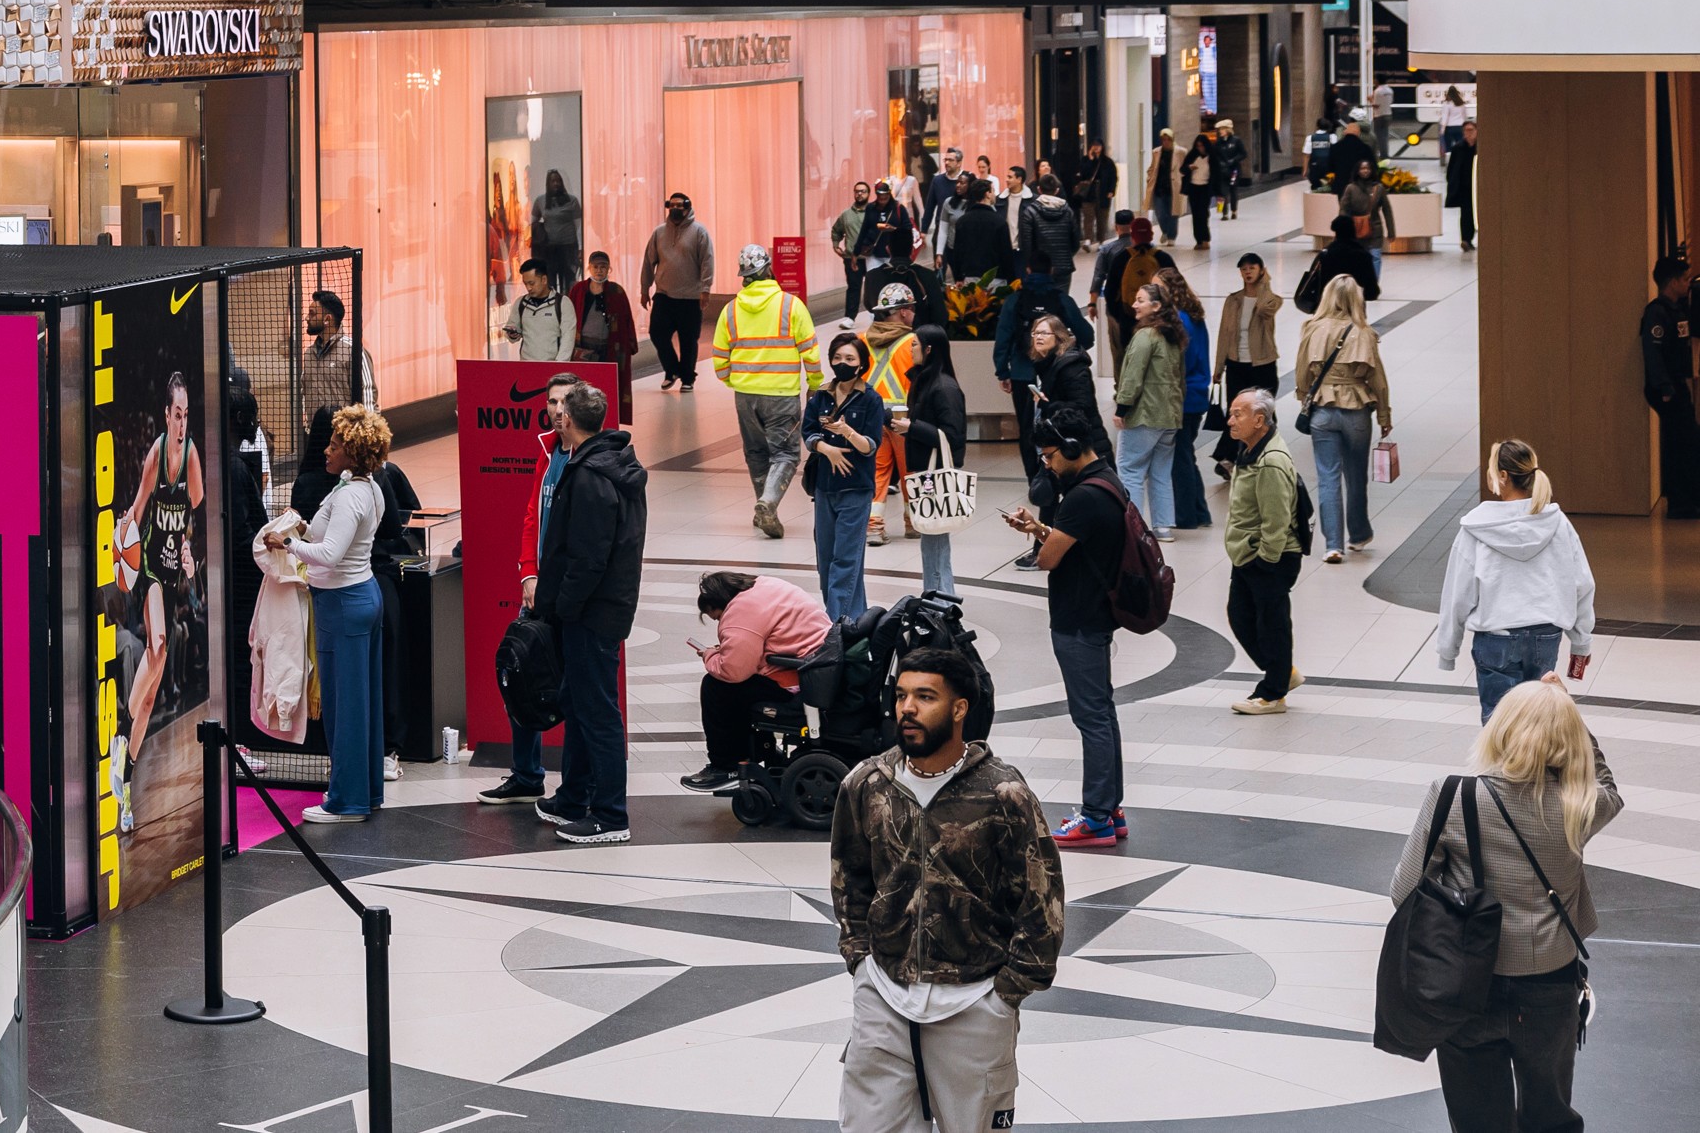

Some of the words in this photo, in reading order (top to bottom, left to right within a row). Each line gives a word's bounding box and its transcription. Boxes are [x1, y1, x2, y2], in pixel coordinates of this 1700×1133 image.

[146, 7, 260, 58] SWAROVSKI
[684, 34, 748, 68] VICTORIA'S
[750, 33, 791, 66] SECRET
[93, 300, 115, 404] IT
[477, 407, 532, 430] NOW
[95, 430, 116, 590] DO
[156, 505, 186, 532] LYNX
[166, 534, 175, 550] 6
[96, 613, 120, 911] JUST
